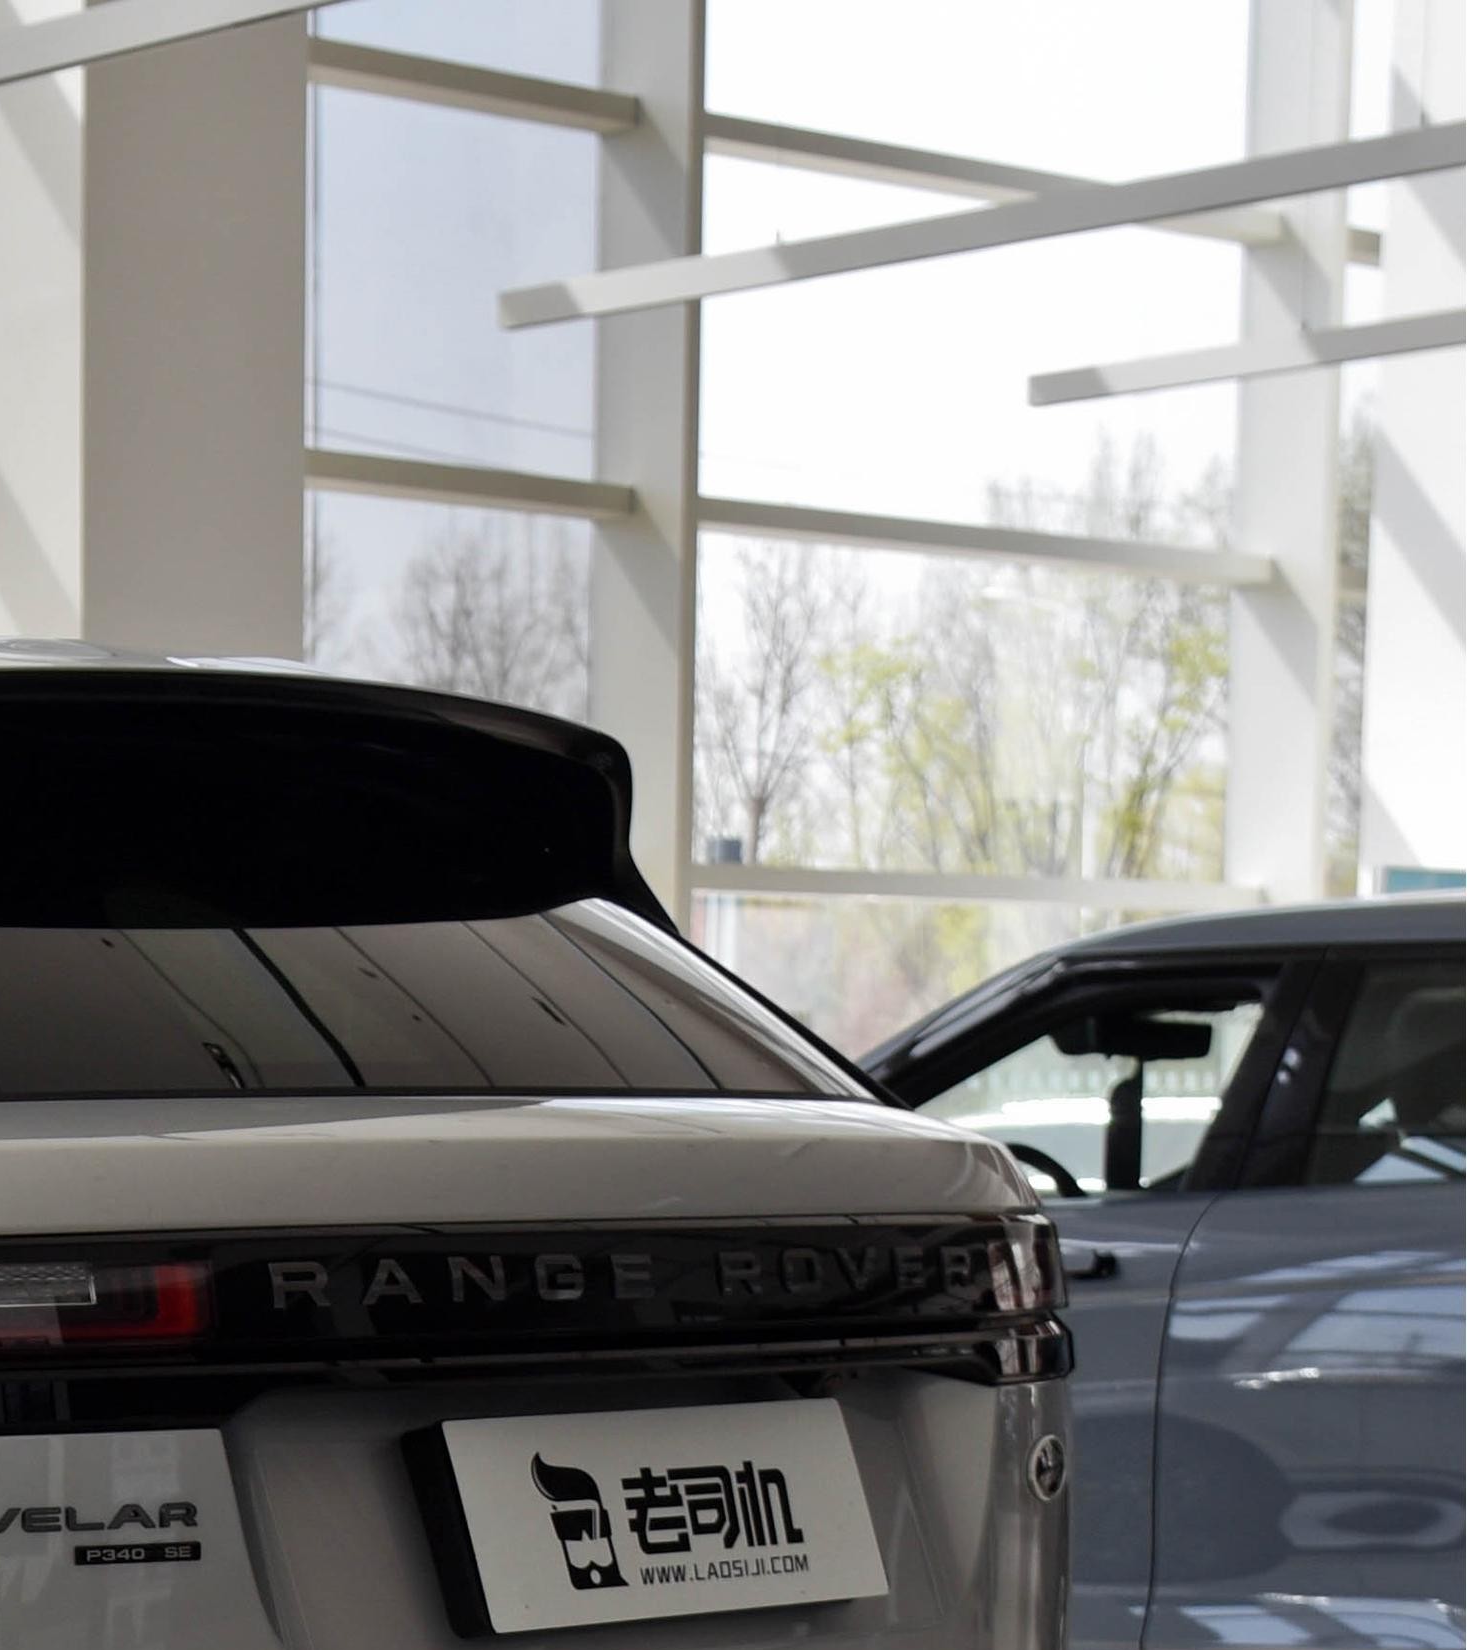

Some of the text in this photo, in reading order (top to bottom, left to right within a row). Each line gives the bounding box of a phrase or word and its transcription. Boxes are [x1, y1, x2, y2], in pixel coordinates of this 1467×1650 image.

[267, 1244, 972, 1309] RANGE ROVER
[620, 1460, 805, 1555] 老司机
[86, 1545, 192, 1563] P340 SE
[640, 1553, 809, 1585] WWW.LAOSIJI.COM
